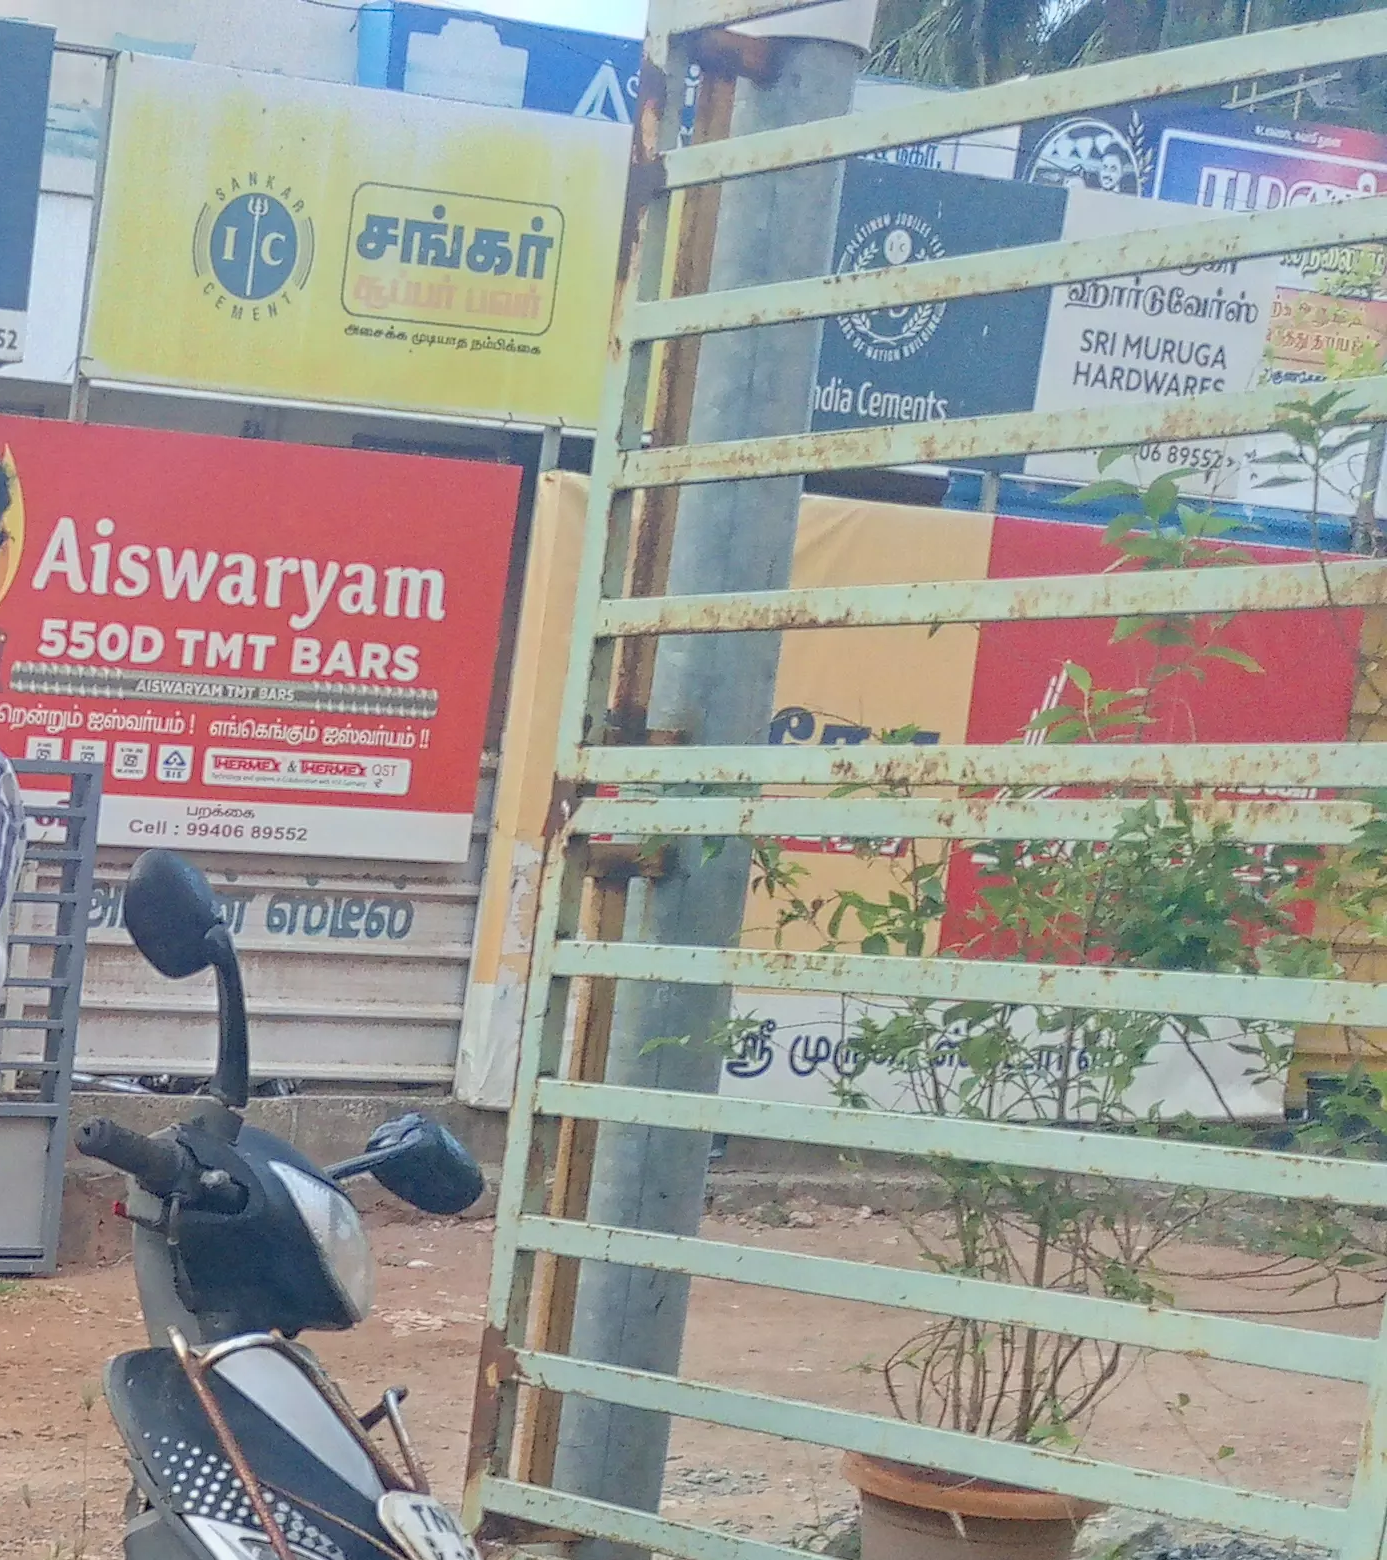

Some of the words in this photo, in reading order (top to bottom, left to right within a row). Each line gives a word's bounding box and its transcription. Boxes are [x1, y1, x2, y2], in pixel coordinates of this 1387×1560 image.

[215, 171, 305, 213] SANKAR
[260, 231, 287, 266] C
[356, 204, 554, 280] சங்கர்
[203, 281, 292, 321] CEMENT
[1065, 276, 1259, 324] ஹார்டுவேர்ஸ்
[1080, 329, 1116, 356] SRI
[1123, 333, 1227, 370] MURUGA
[815, 376, 853, 413] ndia
[858, 381, 949, 419] Cements
[33, 516, 446, 628] Aiswaryam
[37, 619, 164, 664] 550D
[177, 628, 273, 672] TMT
[290, 637, 420, 683] BARS
[136, 678, 226, 700] AISWARYAM
[227, 685, 256, 701] TMT
[258, 686, 295, 702] BARS
[87, 704, 184, 736] ஐஸ்வர்யம்
[209, 713, 319, 745] எங்கெங்கும்
[322, 720, 415, 751] ஐஸ்வர்யம்
[212, 755, 280, 773] THERMEX
[299, 759, 367, 777] THERMEX
[371, 764, 398, 777] QST
[128, 818, 169, 837] Cell
[185, 821, 246, 840] 99406
[250, 824, 308, 844] 89552
[186, 802, 255, 821] பறக்கை
